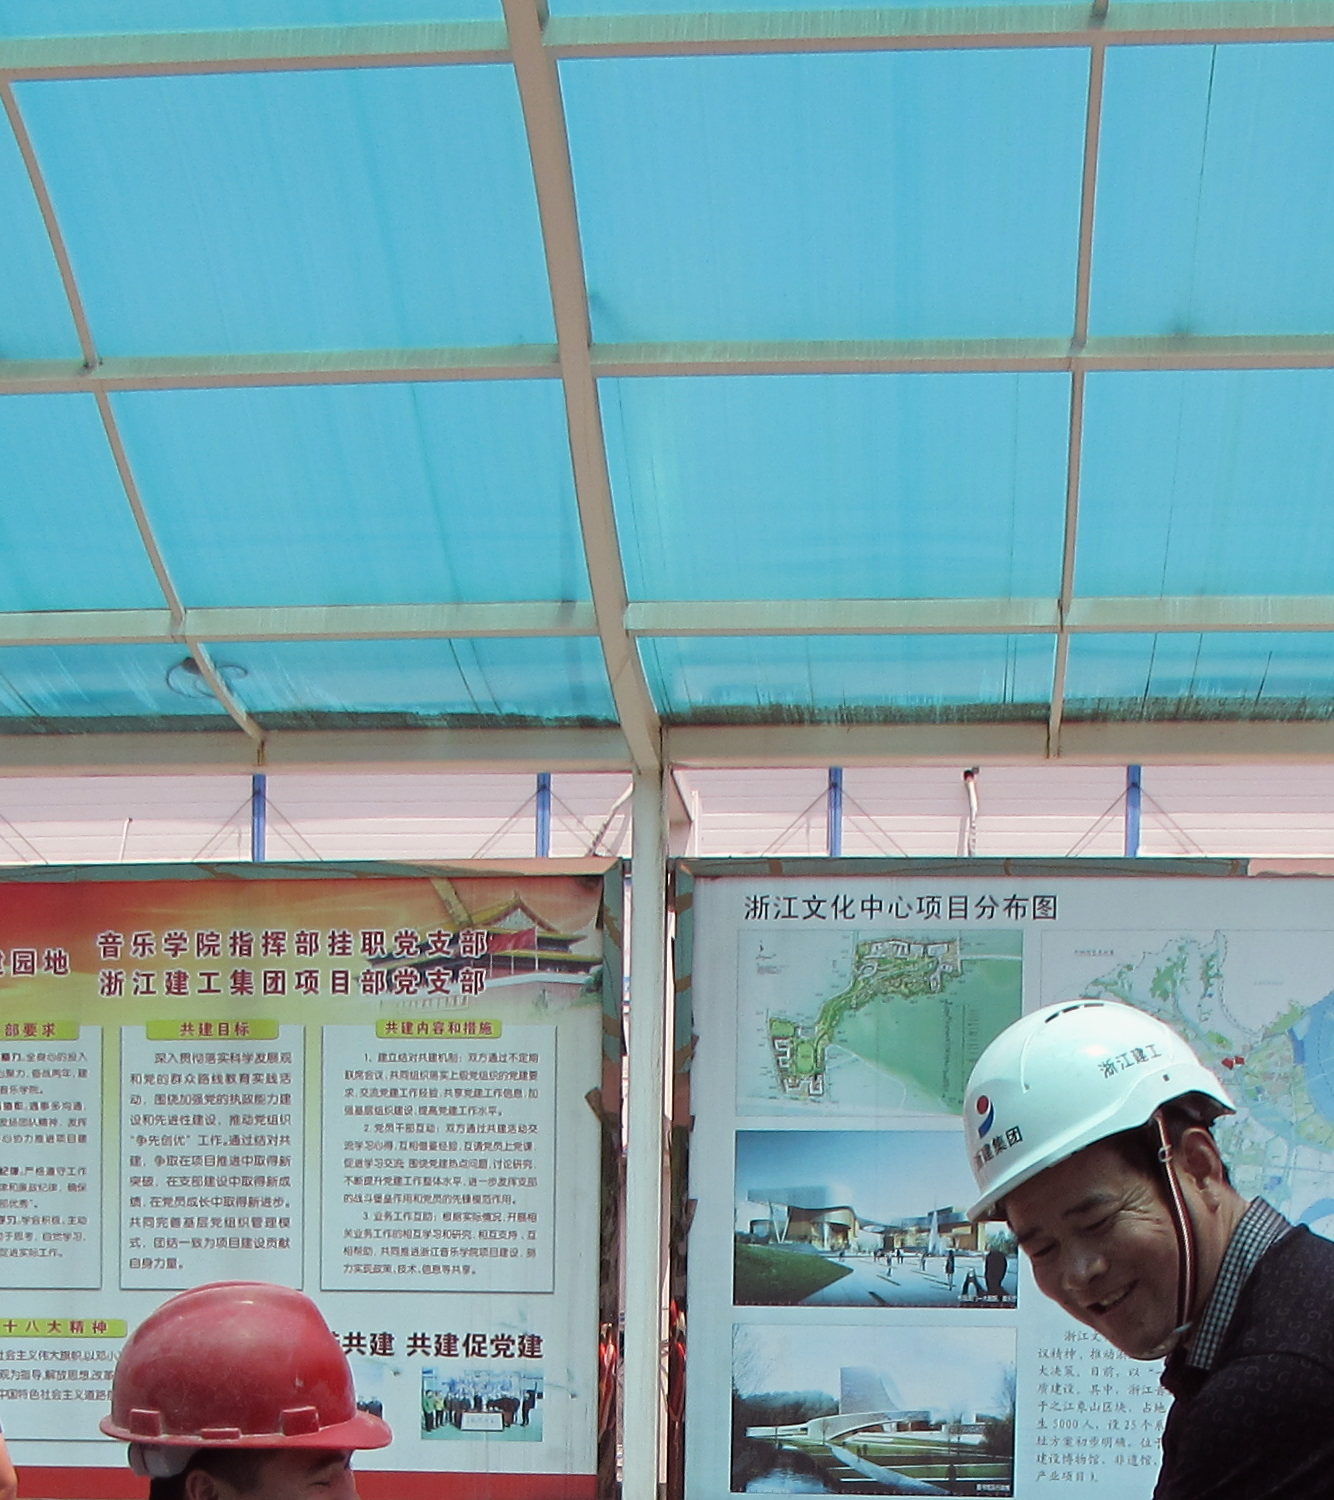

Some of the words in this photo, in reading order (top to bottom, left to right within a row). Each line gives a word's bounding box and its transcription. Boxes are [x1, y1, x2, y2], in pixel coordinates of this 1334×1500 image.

[744, 894, 1057, 920] 浙江文化中心项目分布图
[97, 930, 490, 958] 音乐学院指挥部挂职党支部
[98, 968, 488, 996] 浙江建工集团项目部党支部
[180, 1022, 250, 1036] 共建目标
[385, 1021, 493, 1035] 共建内容和措施
[3, 1320, 108, 1334] 十八大精神
[332, 1331, 395, 1357] 共建
[407, 1332, 544, 1359] 共建促党建
